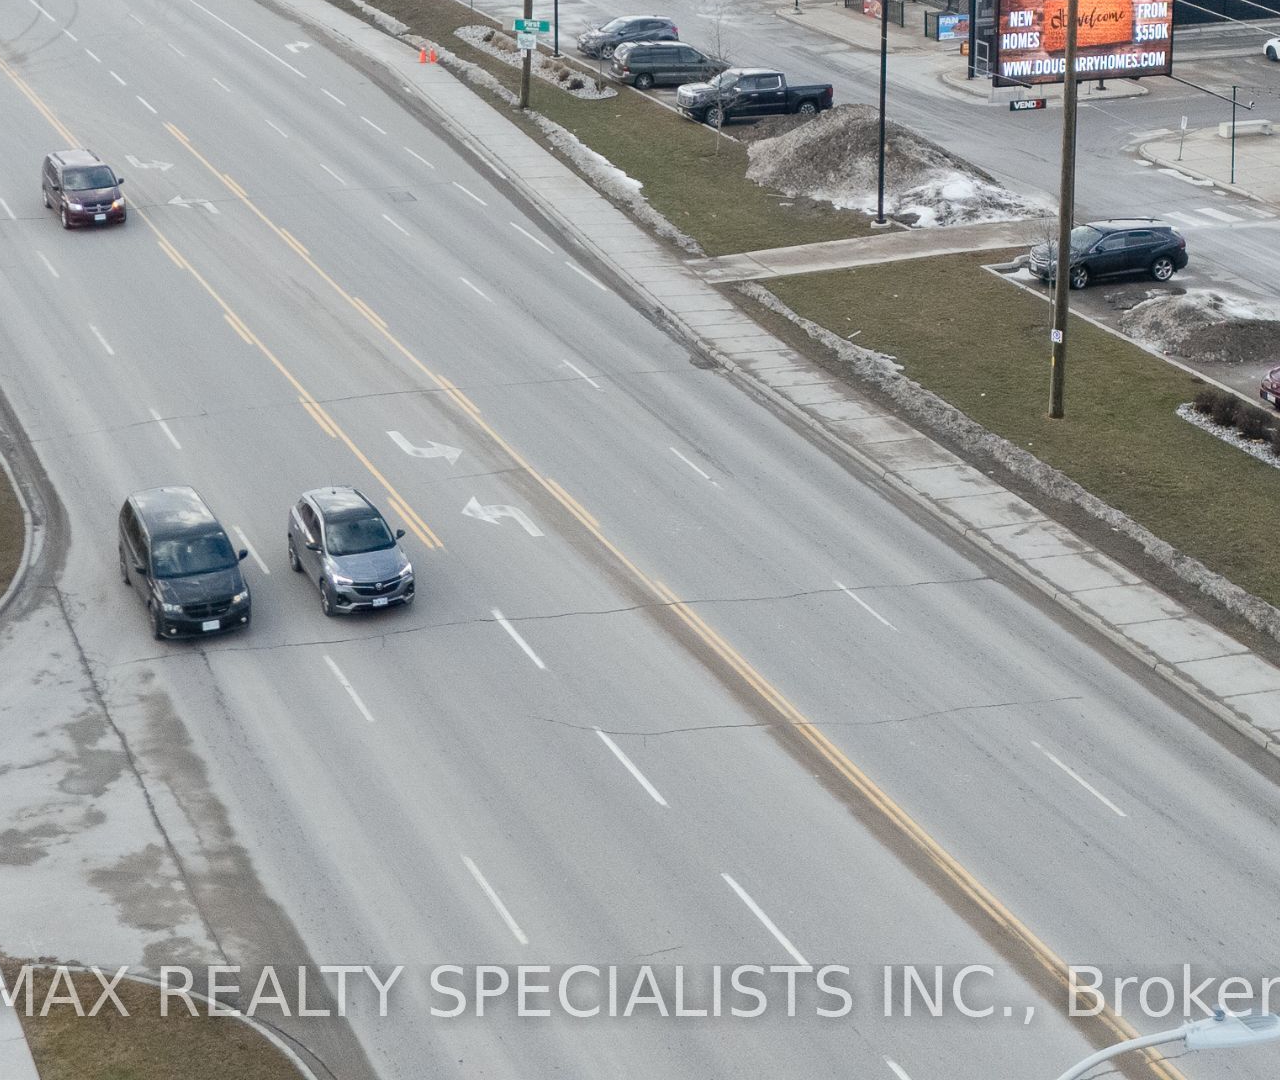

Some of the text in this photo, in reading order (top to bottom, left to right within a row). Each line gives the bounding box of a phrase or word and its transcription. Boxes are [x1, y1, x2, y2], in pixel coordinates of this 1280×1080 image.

[1010, 10, 1035, 28] NEW
[1137, 2, 1168, 19] FROM
[1002, 32, 1040, 50] HOMES
[1135, 23, 1169, 43] $550K
[1003, 51, 1166, 77] WWW.DOUGARRYHOMES.COM
